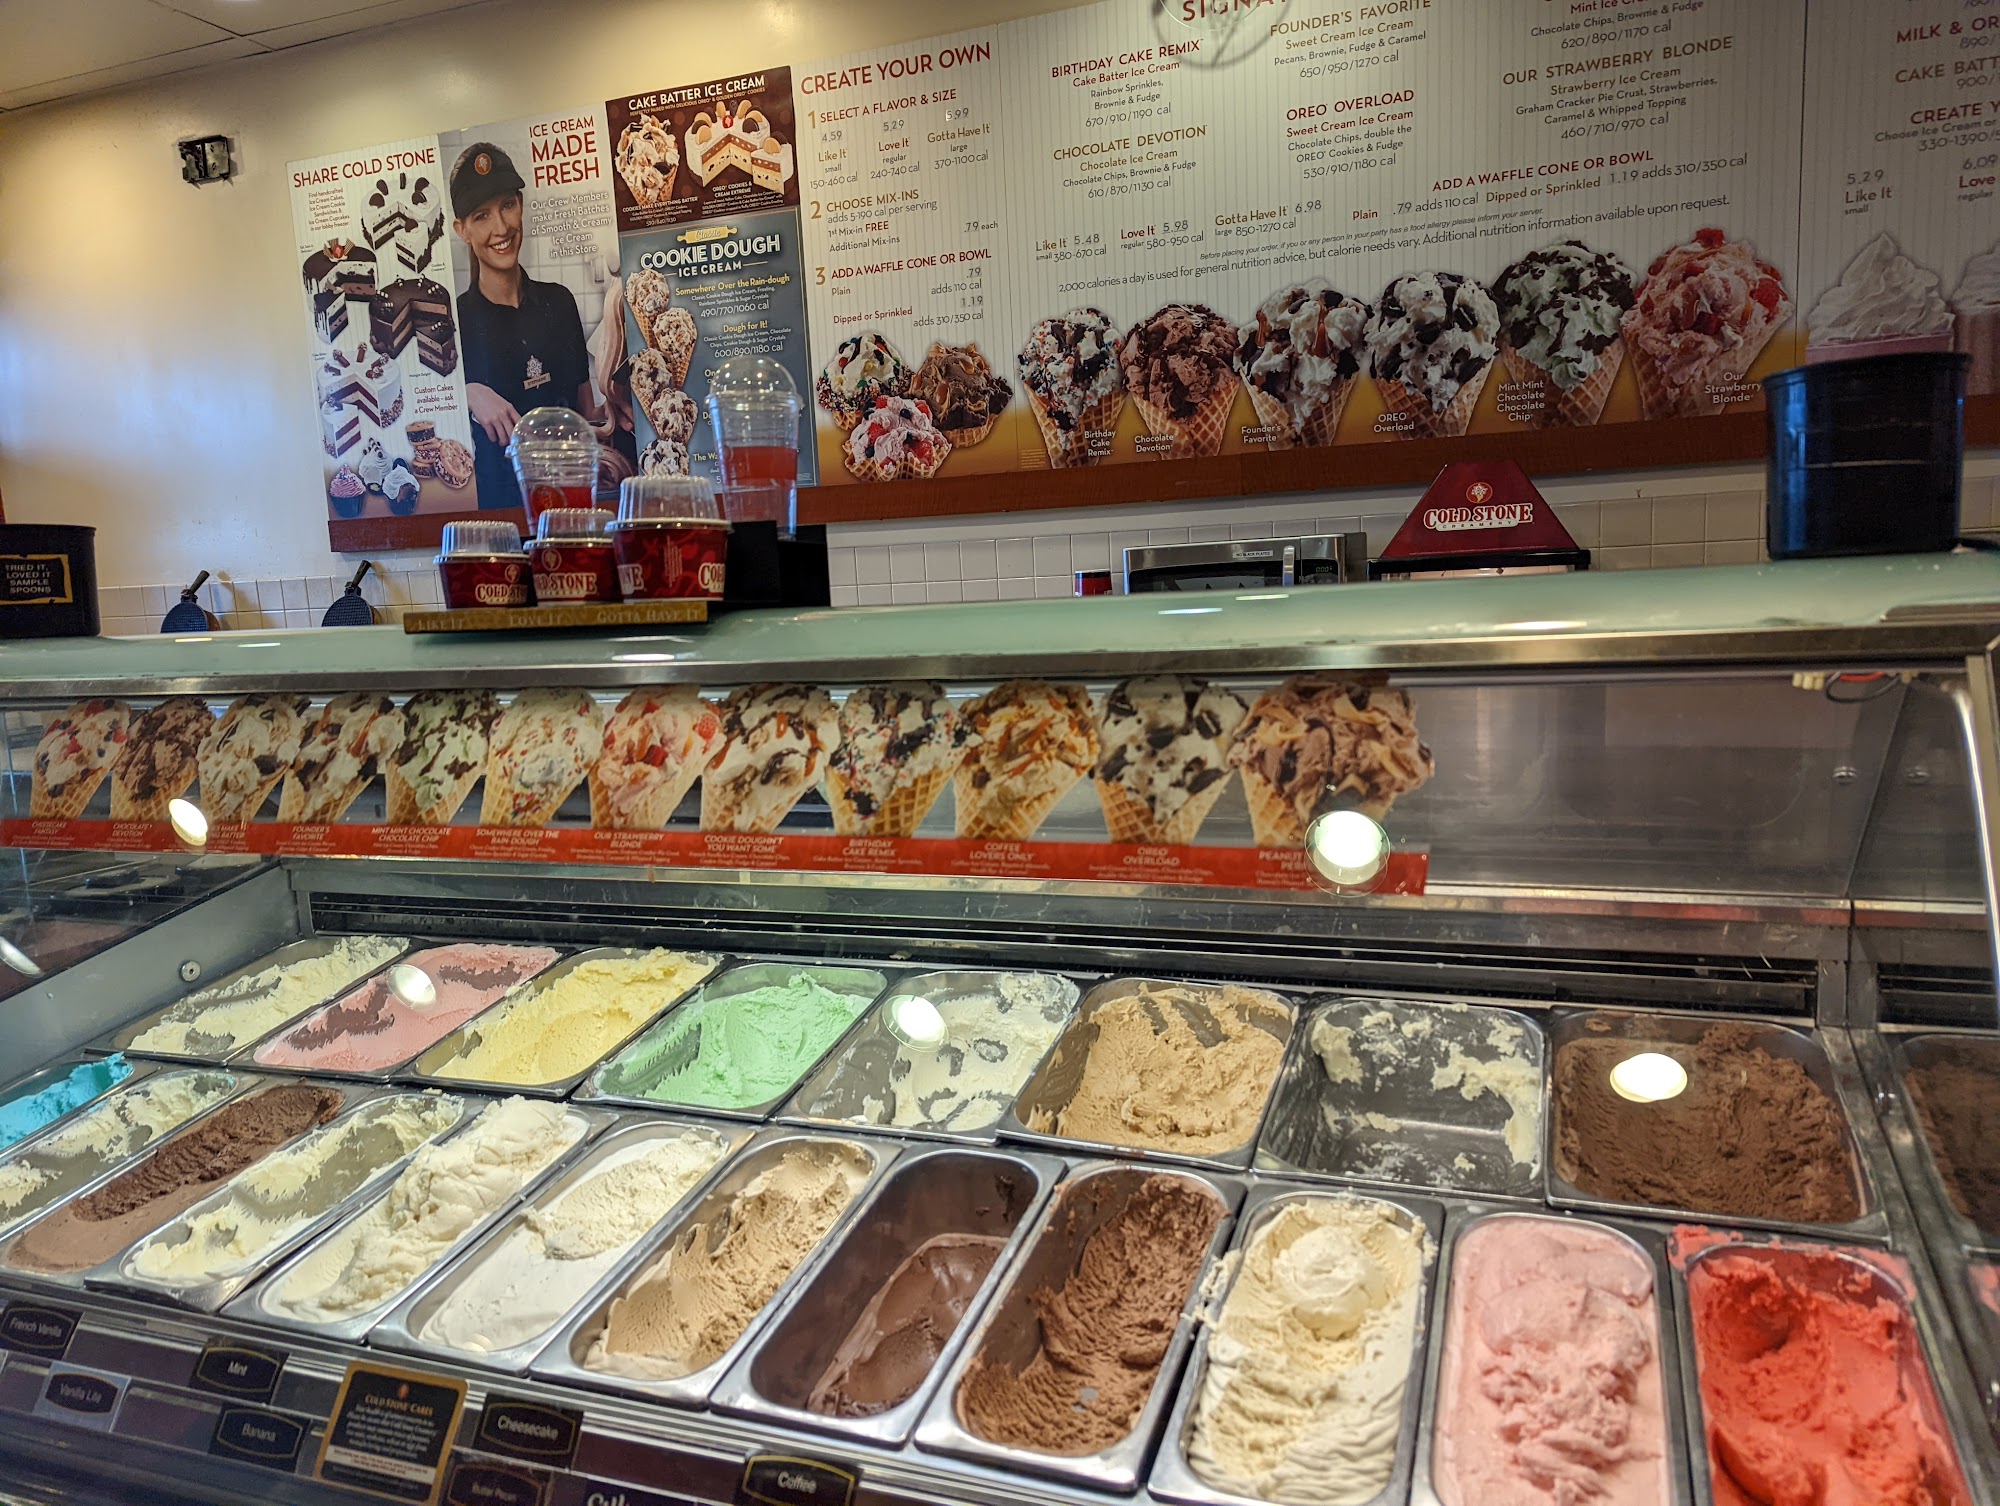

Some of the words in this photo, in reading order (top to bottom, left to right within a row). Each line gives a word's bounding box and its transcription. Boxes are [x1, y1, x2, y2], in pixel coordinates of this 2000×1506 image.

[1270, 11, 1352, 37] FOUNDER'S
[1286, 36, 1317, 50] Sweet
[1321, 30, 1356, 44] Cream
[1359, 26, 1374, 37] Ice
[1377, 20, 1414, 34] Cream
[1052, 56, 1114, 78] BIRTHDAY
[1119, 49, 1153, 65] CAKE
[1159, 39, 1200, 58] REMIX
[1300, 56, 1379, 79] 650/950/1270
[1383, 49, 1399, 63] cal
[1504, 69, 1538, 85] OUR
[1546, 49, 1654, 78] STRAWBERRY
[1663, 36, 1734, 59] BLONDE
[801, 65, 872, 95] CREATE
[876, 54, 933, 80] YOUR
[938, 41, 991, 68] OWN
[628, 96, 657, 111] CAKE
[660, 87, 701, 105] BATTER
[704, 83, 723, 96] ICE
[726, 75, 765, 92] CREAM
[1334, 90, 1414, 113] OVERLOAD
[808, 110, 816, 129] 1
[820, 106, 860, 123] SELECT
[862, 105, 870, 116] A
[873, 96, 917, 114] FLAVOR
[920, 95, 929, 104] &
[932, 88, 957, 103] SIZE
[1156, 102, 1171, 115] cal
[529, 124, 548, 138] ICE
[552, 115, 594, 134] CREAM
[1649, 112, 1669, 127] cal
[927, 130, 956, 143] Gotta
[957, 126, 981, 139] Have
[1054, 138, 1130, 161] CHOCOLATE
[1137, 125, 1207, 147] DEVOTION
[531, 131, 597, 163] MADE
[878, 140, 900, 152] Love
[818, 150, 838, 162] Like
[976, 150, 989, 162] cal
[1380, 153, 1396, 166] cal
[293, 166, 339, 188] SHARE
[342, 158, 382, 179] COLD
[386, 148, 436, 171] STONE
[534, 157, 600, 188] FRESH
[870, 165, 907, 180] 240-740
[908, 161, 920, 173] cal
[846, 171, 858, 183] cal
[1157, 175, 1171, 188] cal
[531, 200, 546, 210] Our
[548, 198, 569, 207] Crew
[571, 191, 609, 204] Members
[810, 200, 822, 219] 2
[826, 196, 873, 213] CHOOSE
[876, 189, 919, 205] MIX-INS
[1845, 189, 1877, 204] Like
[1881, 187, 1892, 199] It
[532, 212, 553, 223] make
[555, 207, 576, 220] Fresh
[578, 203, 609, 215] Batches
[1215, 214, 1248, 226] Gotta
[1250, 209, 1276, 221] Have
[531, 225, 540, 235] of
[541, 222, 571, 235] Smooth
[573, 221, 579, 229] &
[581, 215, 612, 228] Creamy
[839, 226, 863, 236] Mix-in
[865, 221, 889, 232] FREE
[552, 236, 564, 245] Ice
[566, 233, 593, 244] Cream
[1120, 229, 1145, 240] Love
[551, 249, 558, 258] in
[560, 246, 573, 256] this
[575, 244, 597, 255] Store
[641, 246, 707, 269] COOKIE
[711, 234, 781, 260] DOUGH
[1036, 240, 1057, 251] Like
[679, 268, 698, 277] ICE
[701, 260, 742, 274] CREAM
[815, 266, 826, 285] 3
[831, 267, 854, 280] ADD
[855, 267, 863, 276] A
[864, 260, 904, 275] WAFFLE
[906, 255, 937, 269] CONE
[940, 252, 956, 264] OR
[959, 248, 992, 262] BOWL
[675, 284, 716, 296] Somewhere
[718, 281, 735, 290] Over
[737, 279, 749, 287] the
[758, 300, 769, 310] cal
[723, 324, 745, 334] Dough
[747, 321, 759, 330] for
[771, 342, 783, 352] cal
[1723, 372, 1744, 381] Our
[1704, 383, 1761, 394] Strawberry
[1712, 394, 1750, 404] Blonde
[1084, 430, 1116, 440] Birthday
[1373, 421, 1415, 433] Overload
[1090, 439, 1110, 448] Cake
[1134, 434, 1174, 444] Chocolate
[1087, 448, 1111, 457] Remix
[1136, 443, 1171, 453] Devotion
[1424, 508, 1471, 529] COLD
[1472, 503, 1532, 524] STONE
[777, 1471, 817, 1495] Coffee
